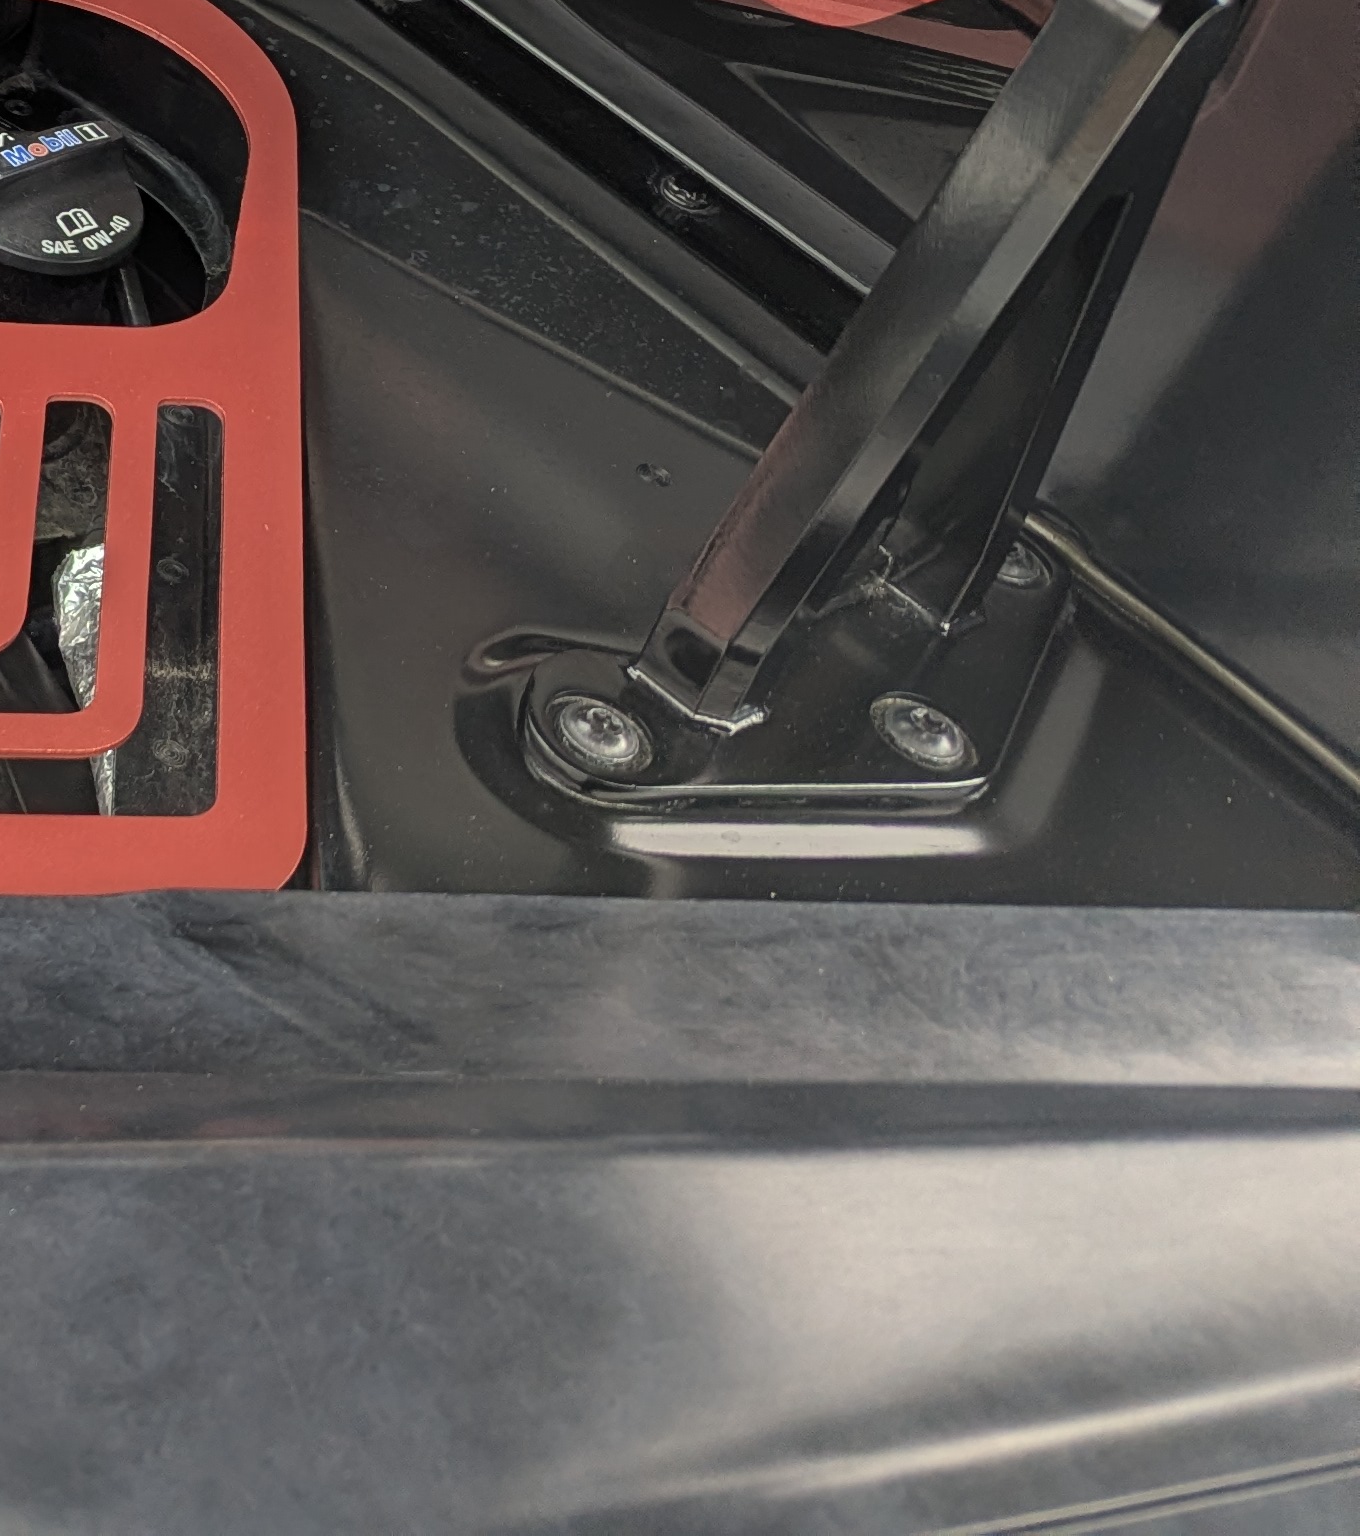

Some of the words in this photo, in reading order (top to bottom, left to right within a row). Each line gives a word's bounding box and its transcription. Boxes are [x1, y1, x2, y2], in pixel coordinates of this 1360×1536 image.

[0, 128, 83, 167] Mobil
[41, 239, 79, 254] SAE
[82, 215, 131, 251] 0W-40
